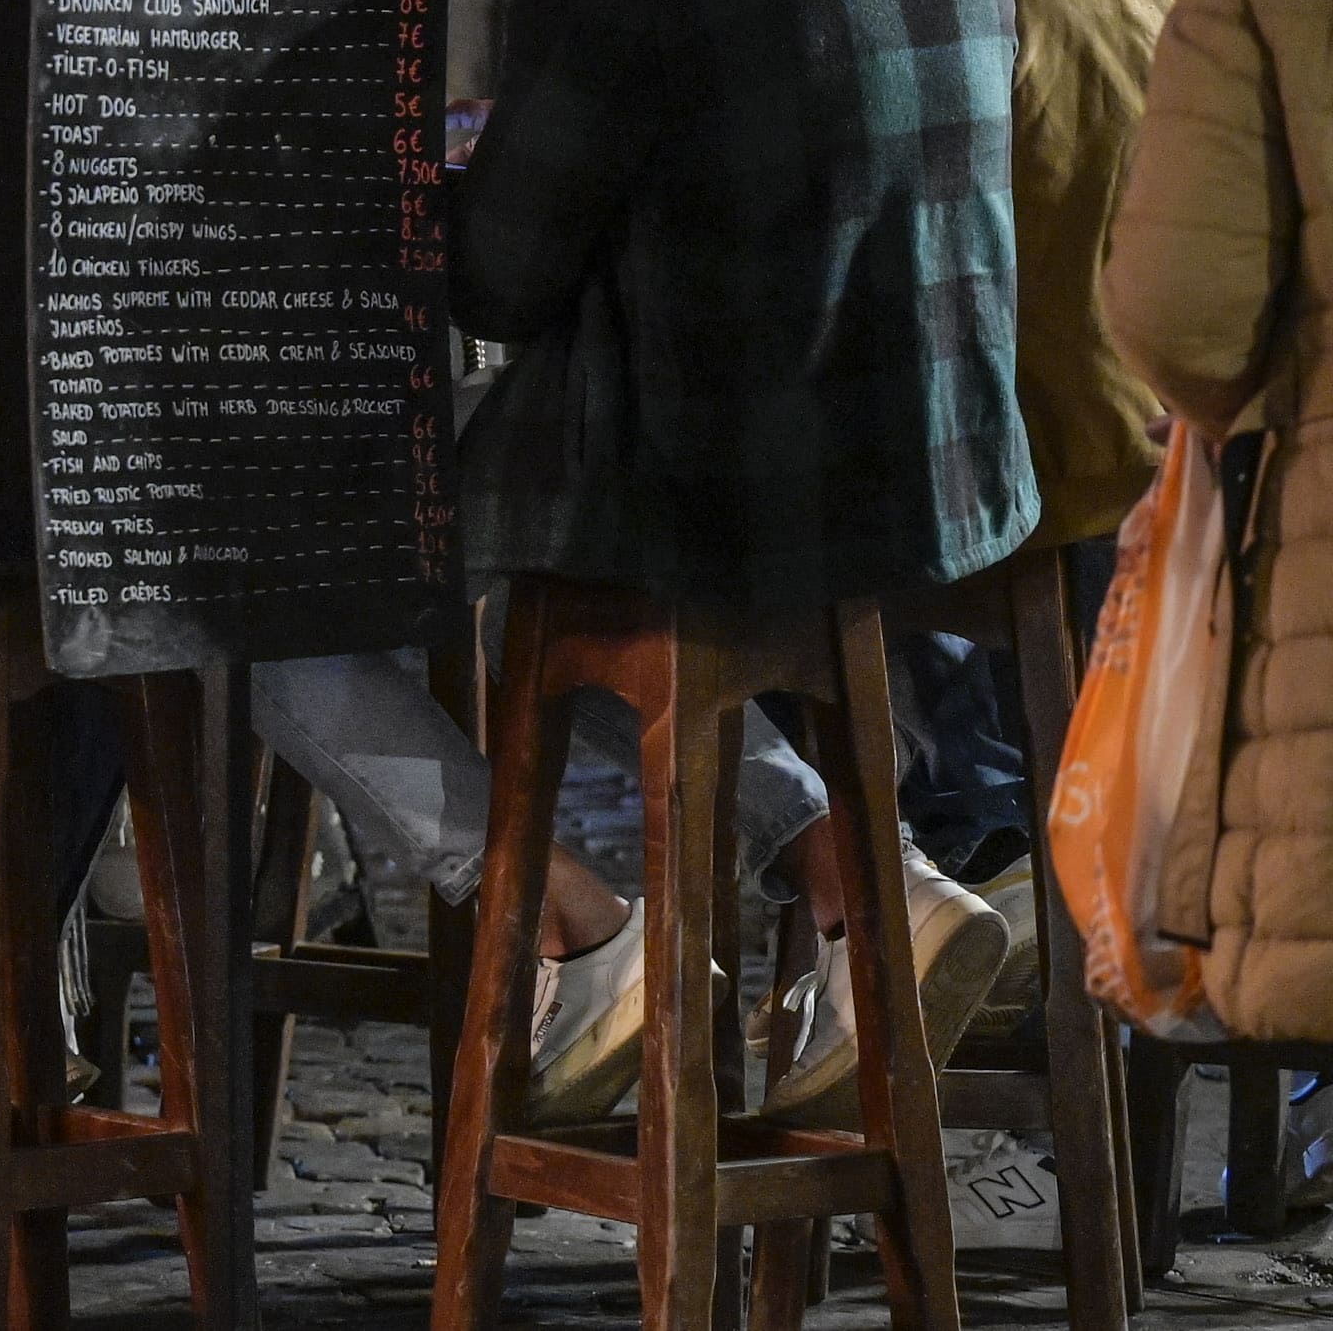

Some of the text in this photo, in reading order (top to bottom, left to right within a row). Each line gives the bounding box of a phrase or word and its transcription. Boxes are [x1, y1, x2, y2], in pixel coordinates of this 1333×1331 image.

[151, 28, 241, 51] HAMBURGER
[52, 93, 88, 116] HOT
[98, 94, 136, 118] DOG
[49, 125, 103, 145] TOAST
[52, 149, 65, 176] 8
[69, 157, 138, 178] NUGGETS
[50, 181, 63, 206] 5
[68, 181, 139, 205] JALAPEÑO
[146, 183, 205, 204] POPPERS
[50, 211, 63, 238] 8
[48, 247, 67, 277] 10
[48, 293, 102, 312] NACHOS
[113, 290, 170, 310] SUPREME
[221, 290, 278, 309] CEDDAR
[284, 291, 334, 309] CHEESE
[342, 288, 353, 310] &
[360, 290, 399, 309] SALSA
[50, 315, 124, 338] JALAPEÑOS
[48, 350, 94, 371] BAKED
[99, 345, 163, 364] POTATOES
[219, 344, 270, 362] CEDDAR
[279, 345, 324, 361] CREAM
[331, 340, 341, 362] &
[49, 378, 103, 395] TOMATO
[48, 401, 93, 420] BAKED
[99, 401, 162, 419] POTATOES
[219, 399, 257, 415] HERB
[52, 429, 88, 446] SALAD
[93, 455, 120, 473] AND
[146, 483, 204, 500] POTATOES
[51, 519, 104, 537] FRENCH
[59, 549, 112, 568] SMOKED
[124, 548, 172, 566] SALMON
[193, 544, 248, 562] AVOCADO
[121, 580, 172, 603] CRÊPES
[969, 1166, 1046, 1218] N
